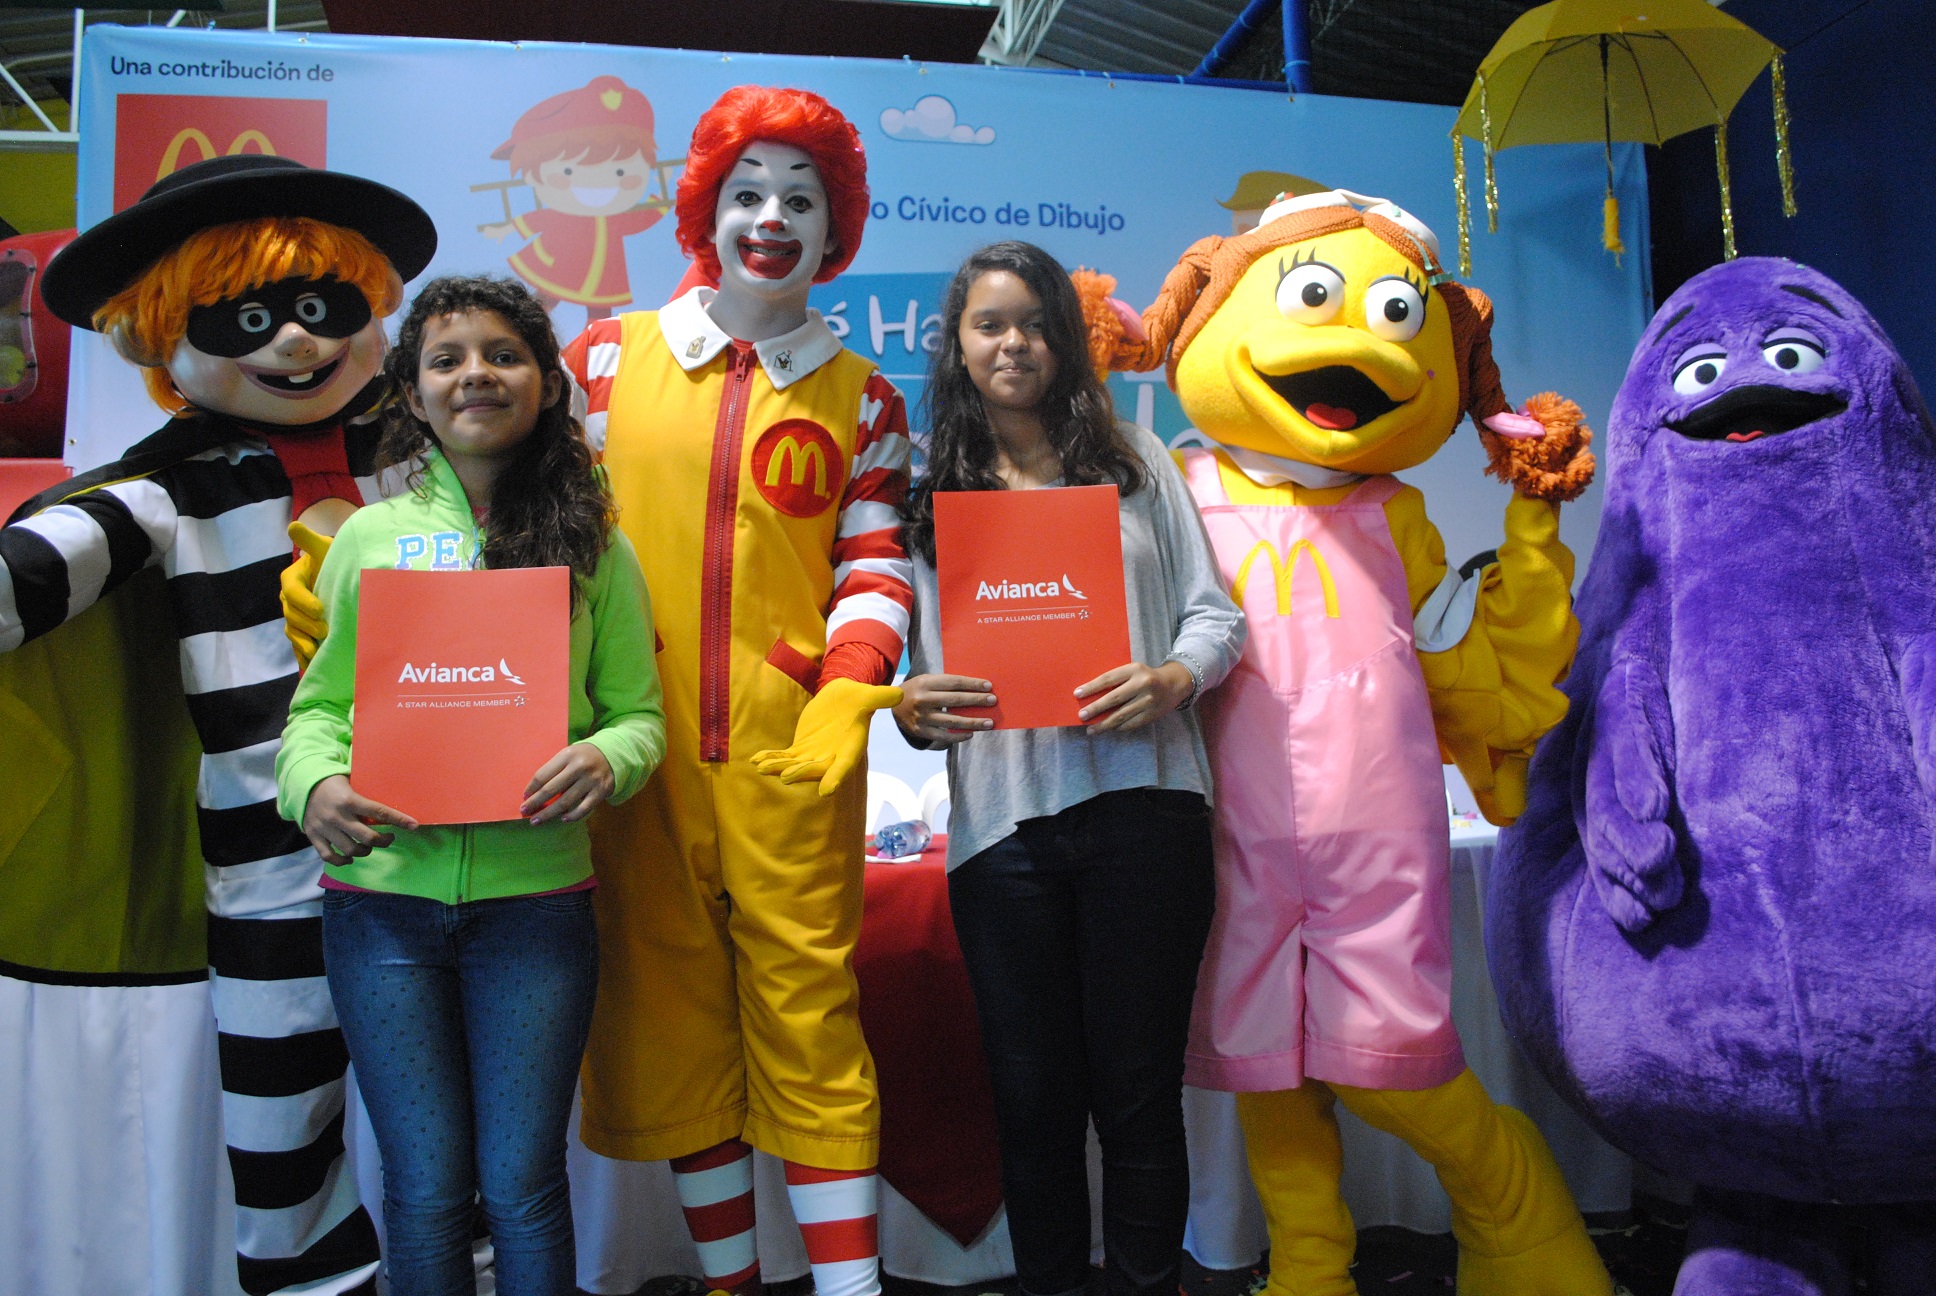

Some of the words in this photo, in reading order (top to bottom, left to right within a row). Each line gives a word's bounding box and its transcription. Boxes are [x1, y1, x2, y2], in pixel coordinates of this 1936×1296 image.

[110, 56, 152, 76] Una
[158, 59, 301, 81] contribución
[306, 64, 335, 82] de
[897, 195, 987, 224] Cívico
[994, 202, 1030, 226] de
[1037, 202, 1125, 235] Dibujo
[975, 579, 1060, 601] Avianca
[983, 616, 1003, 624] STAR
[1004, 614, 1041, 622] ALLIANCE
[1042, 612, 1076, 620] MEMBER
[397, 662, 495, 684] Avianca
[429, 700, 471, 708] ALLIANCE
[473, 699, 511, 707] MEMBER
